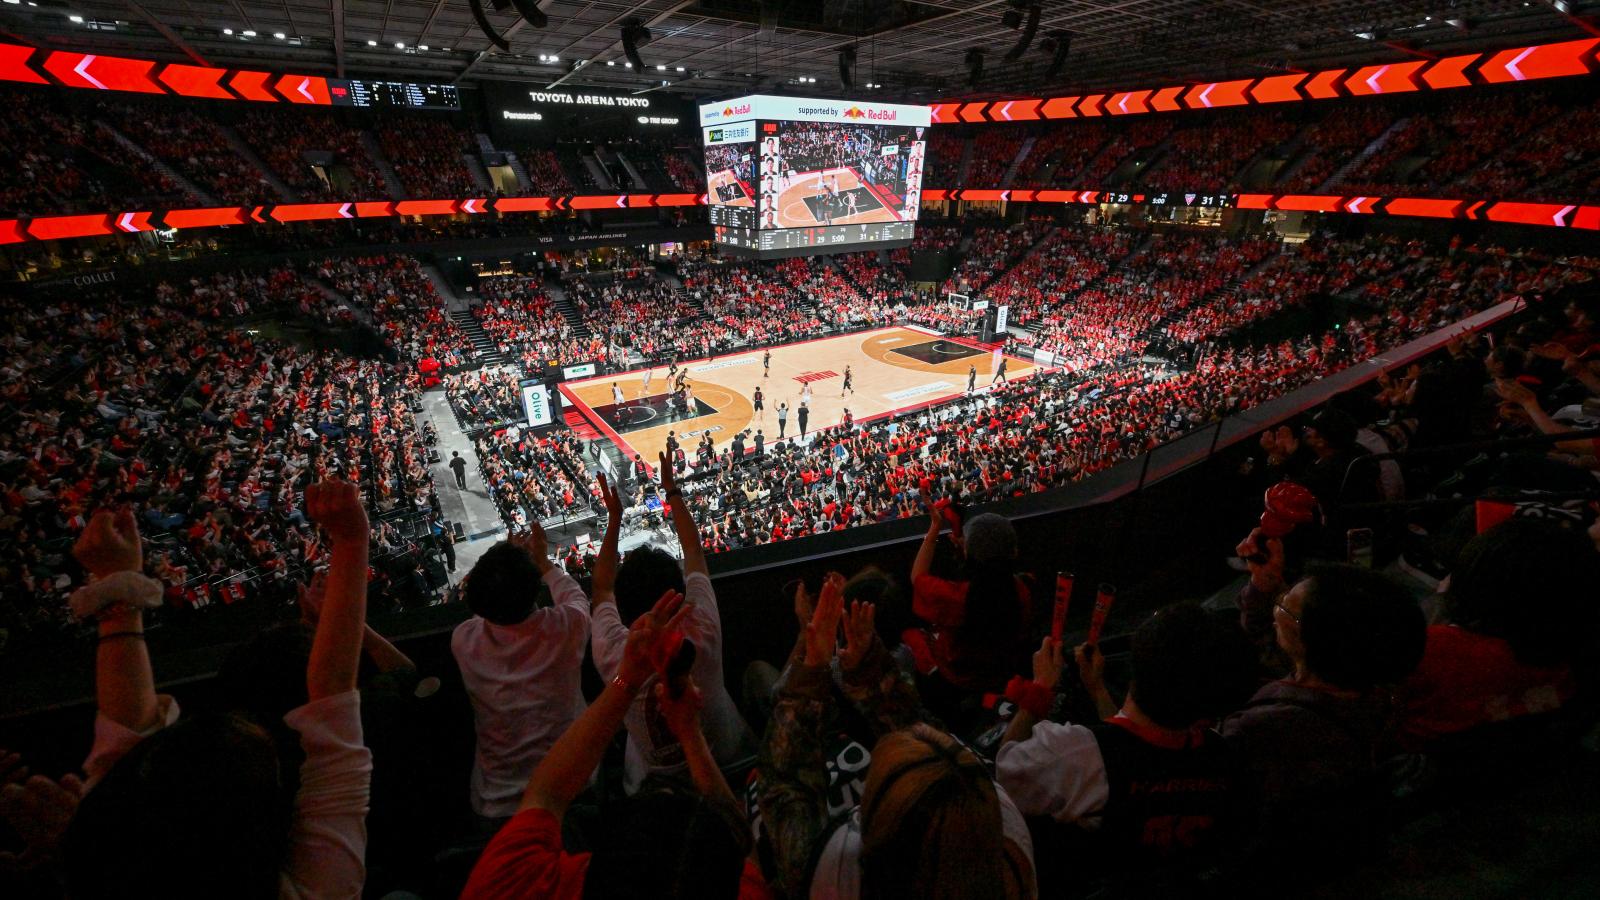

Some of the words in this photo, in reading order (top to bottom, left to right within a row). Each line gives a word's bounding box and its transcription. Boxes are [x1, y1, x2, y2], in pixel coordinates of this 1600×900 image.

[529, 92, 573, 104] TOYOTA
[576, 95, 615, 105] ARENA
[615, 97, 649, 107] TOKYO
[503, 110, 542, 120] Panasonic
[798, 107, 830, 116] supported
[830, 107, 839, 117] by
[660, 117, 679, 125] GROUP
[1117, 194, 1129, 203] 29
[1152, 197, 1166, 205] 5:00
[1201, 196, 1214, 205] 31
[817, 236, 825, 244] 29
[831, 234, 845, 243] 5:00
[859, 233, 867, 241] 31
[73, 271, 116, 287] COLLET
[531, 392, 542, 420] Olive
